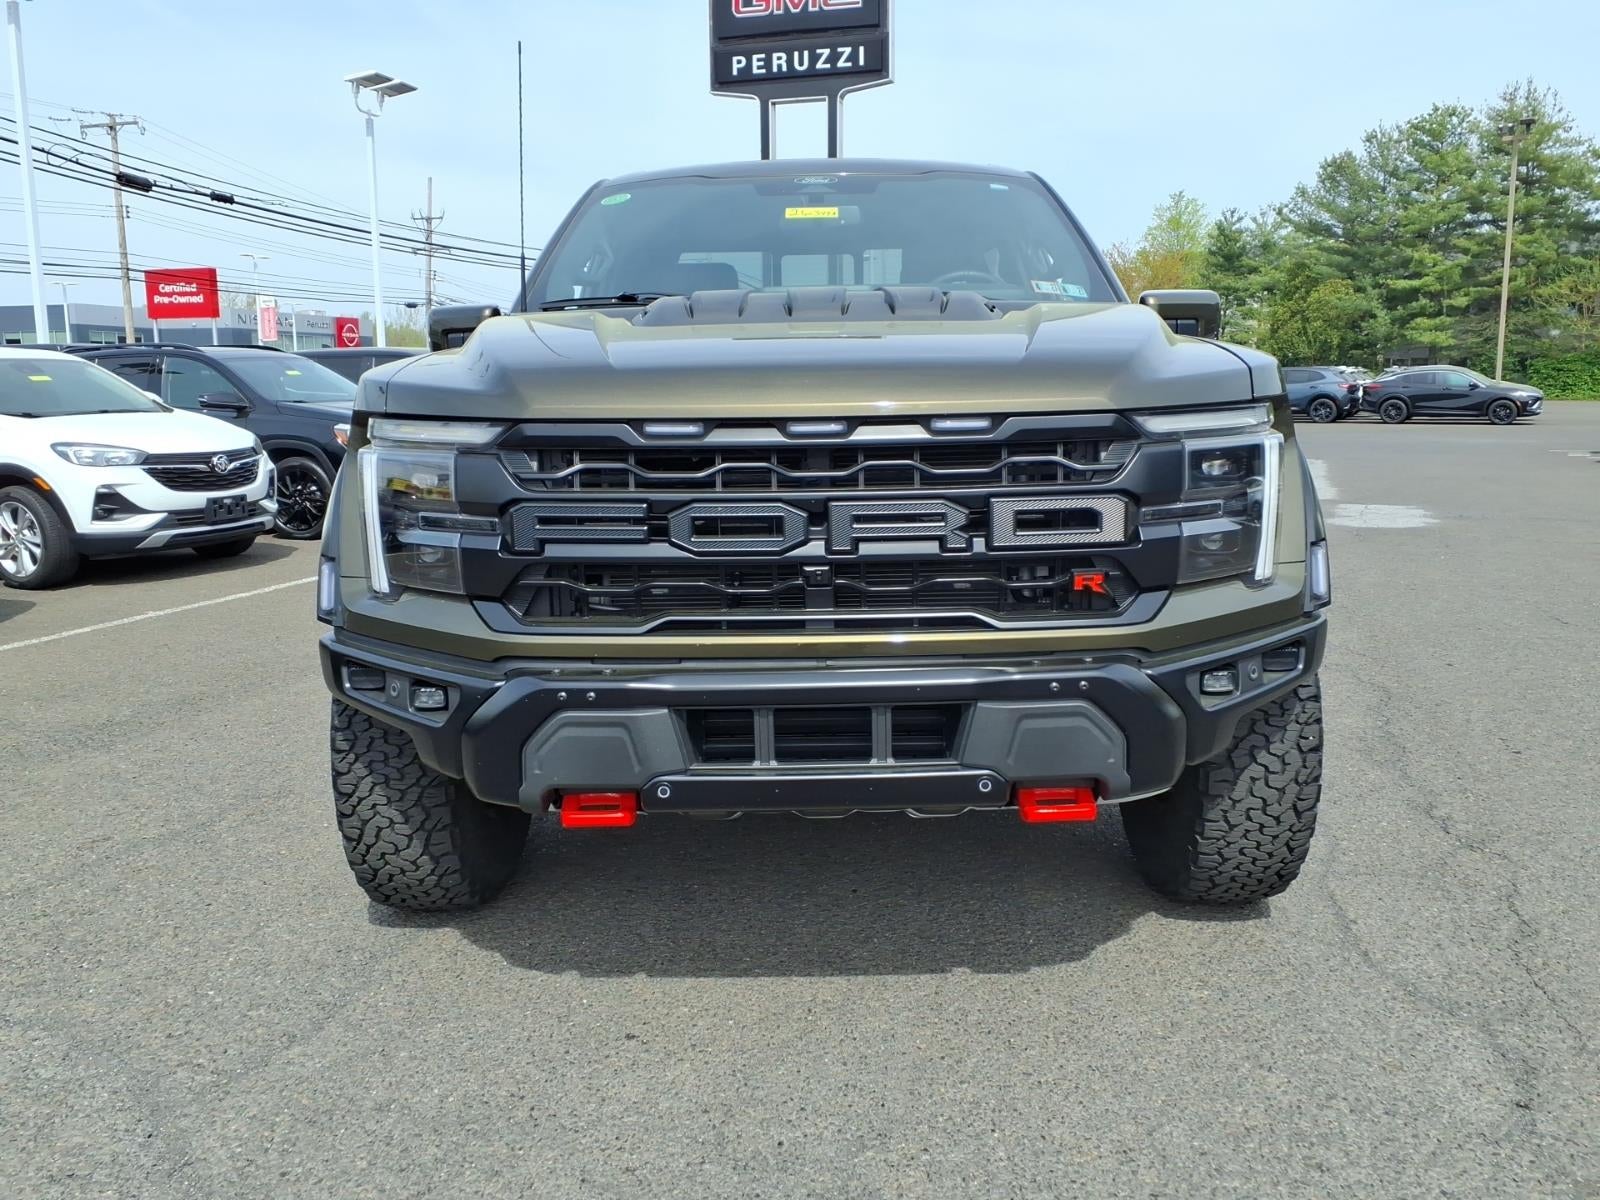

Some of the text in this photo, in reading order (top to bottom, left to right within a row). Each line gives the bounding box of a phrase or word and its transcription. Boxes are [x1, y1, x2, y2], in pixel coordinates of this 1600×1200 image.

[732, 45, 865, 76] PERUZZI
[159, 282, 197, 293] Certified
[153, 293, 204, 304] Pre-Owned
[237, 313, 294, 327] NISAN
[507, 496, 1129, 554] FORD
